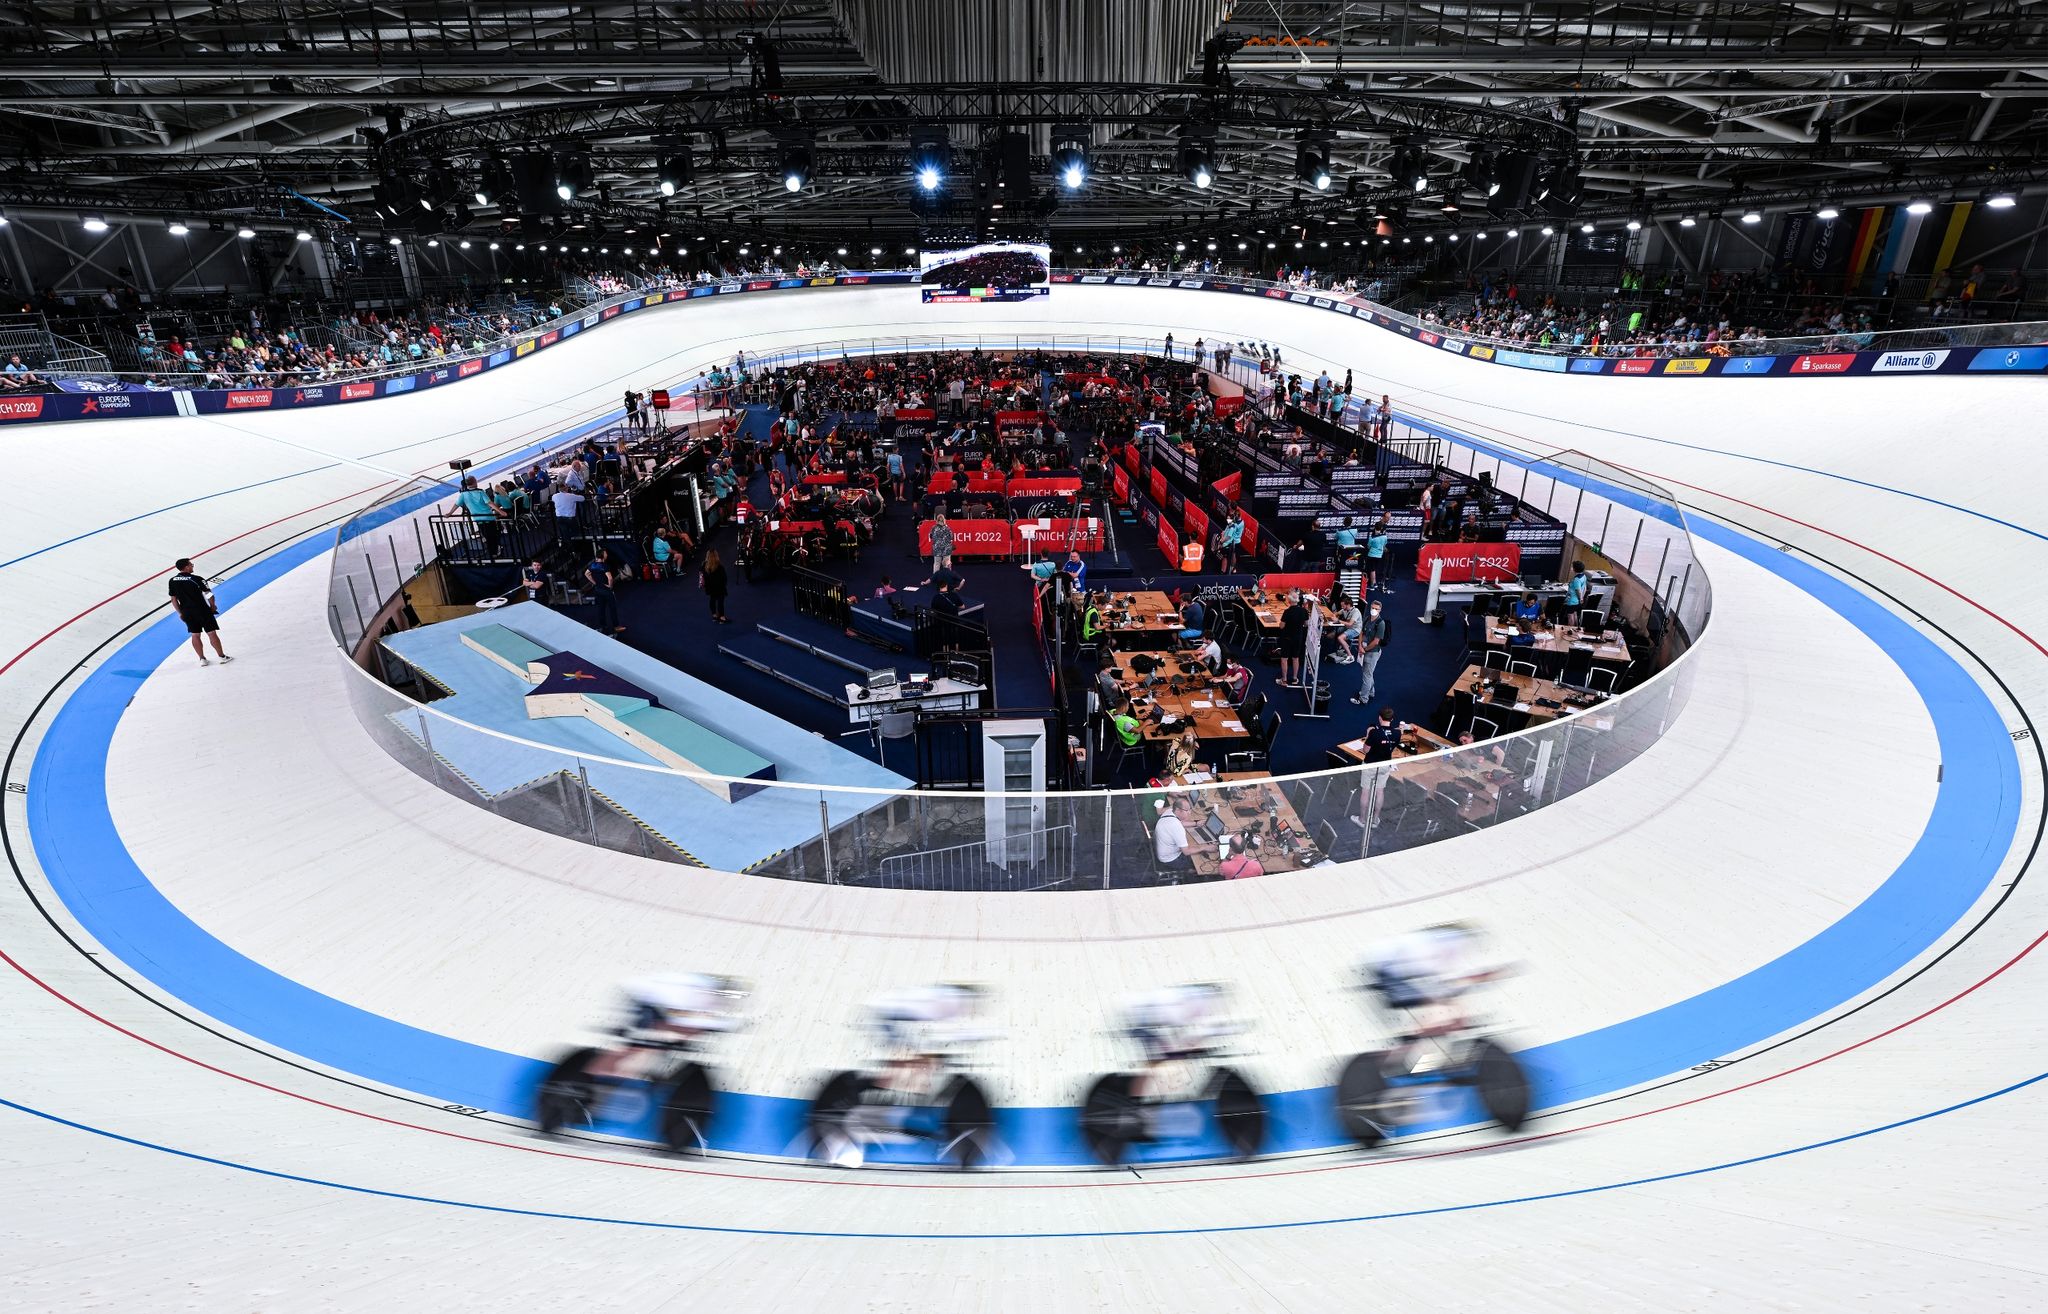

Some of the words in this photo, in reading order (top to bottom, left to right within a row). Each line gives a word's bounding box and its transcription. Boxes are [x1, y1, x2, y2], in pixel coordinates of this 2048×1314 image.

[1884, 352, 1919, 367] Allianz
[1812, 362, 1842, 371] Sparkasse
[98, 395, 130, 403] EUROPEAN
[232, 395, 254, 404] MUNICH
[255, 394, 269, 403] 2022
[16, 402, 38, 413] 2022
[909, 427, 926, 435] UEC
[1014, 489, 1051, 497] MUNICH
[975, 532, 1001, 542] 2022
[1479, 557, 1510, 568] 2022
